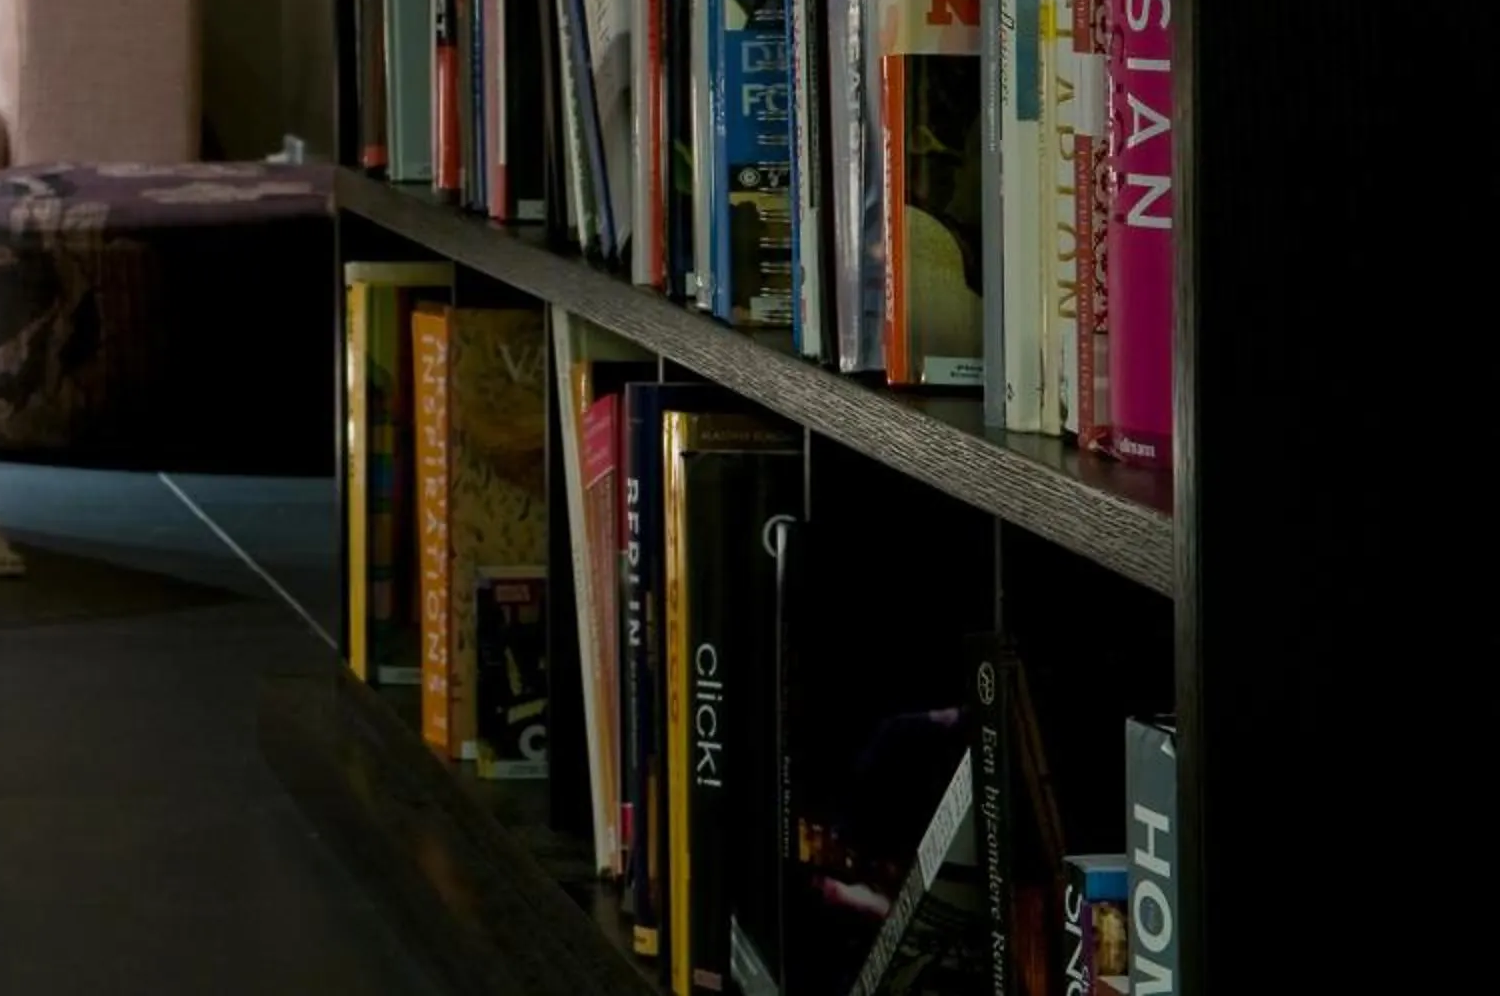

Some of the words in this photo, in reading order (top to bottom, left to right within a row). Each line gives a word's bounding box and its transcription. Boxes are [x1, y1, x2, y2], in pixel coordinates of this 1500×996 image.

[626, 476, 642, 647] BERLIN
[695, 642, 724, 789] click!
[980, 785, 1005, 922] bijzondere
